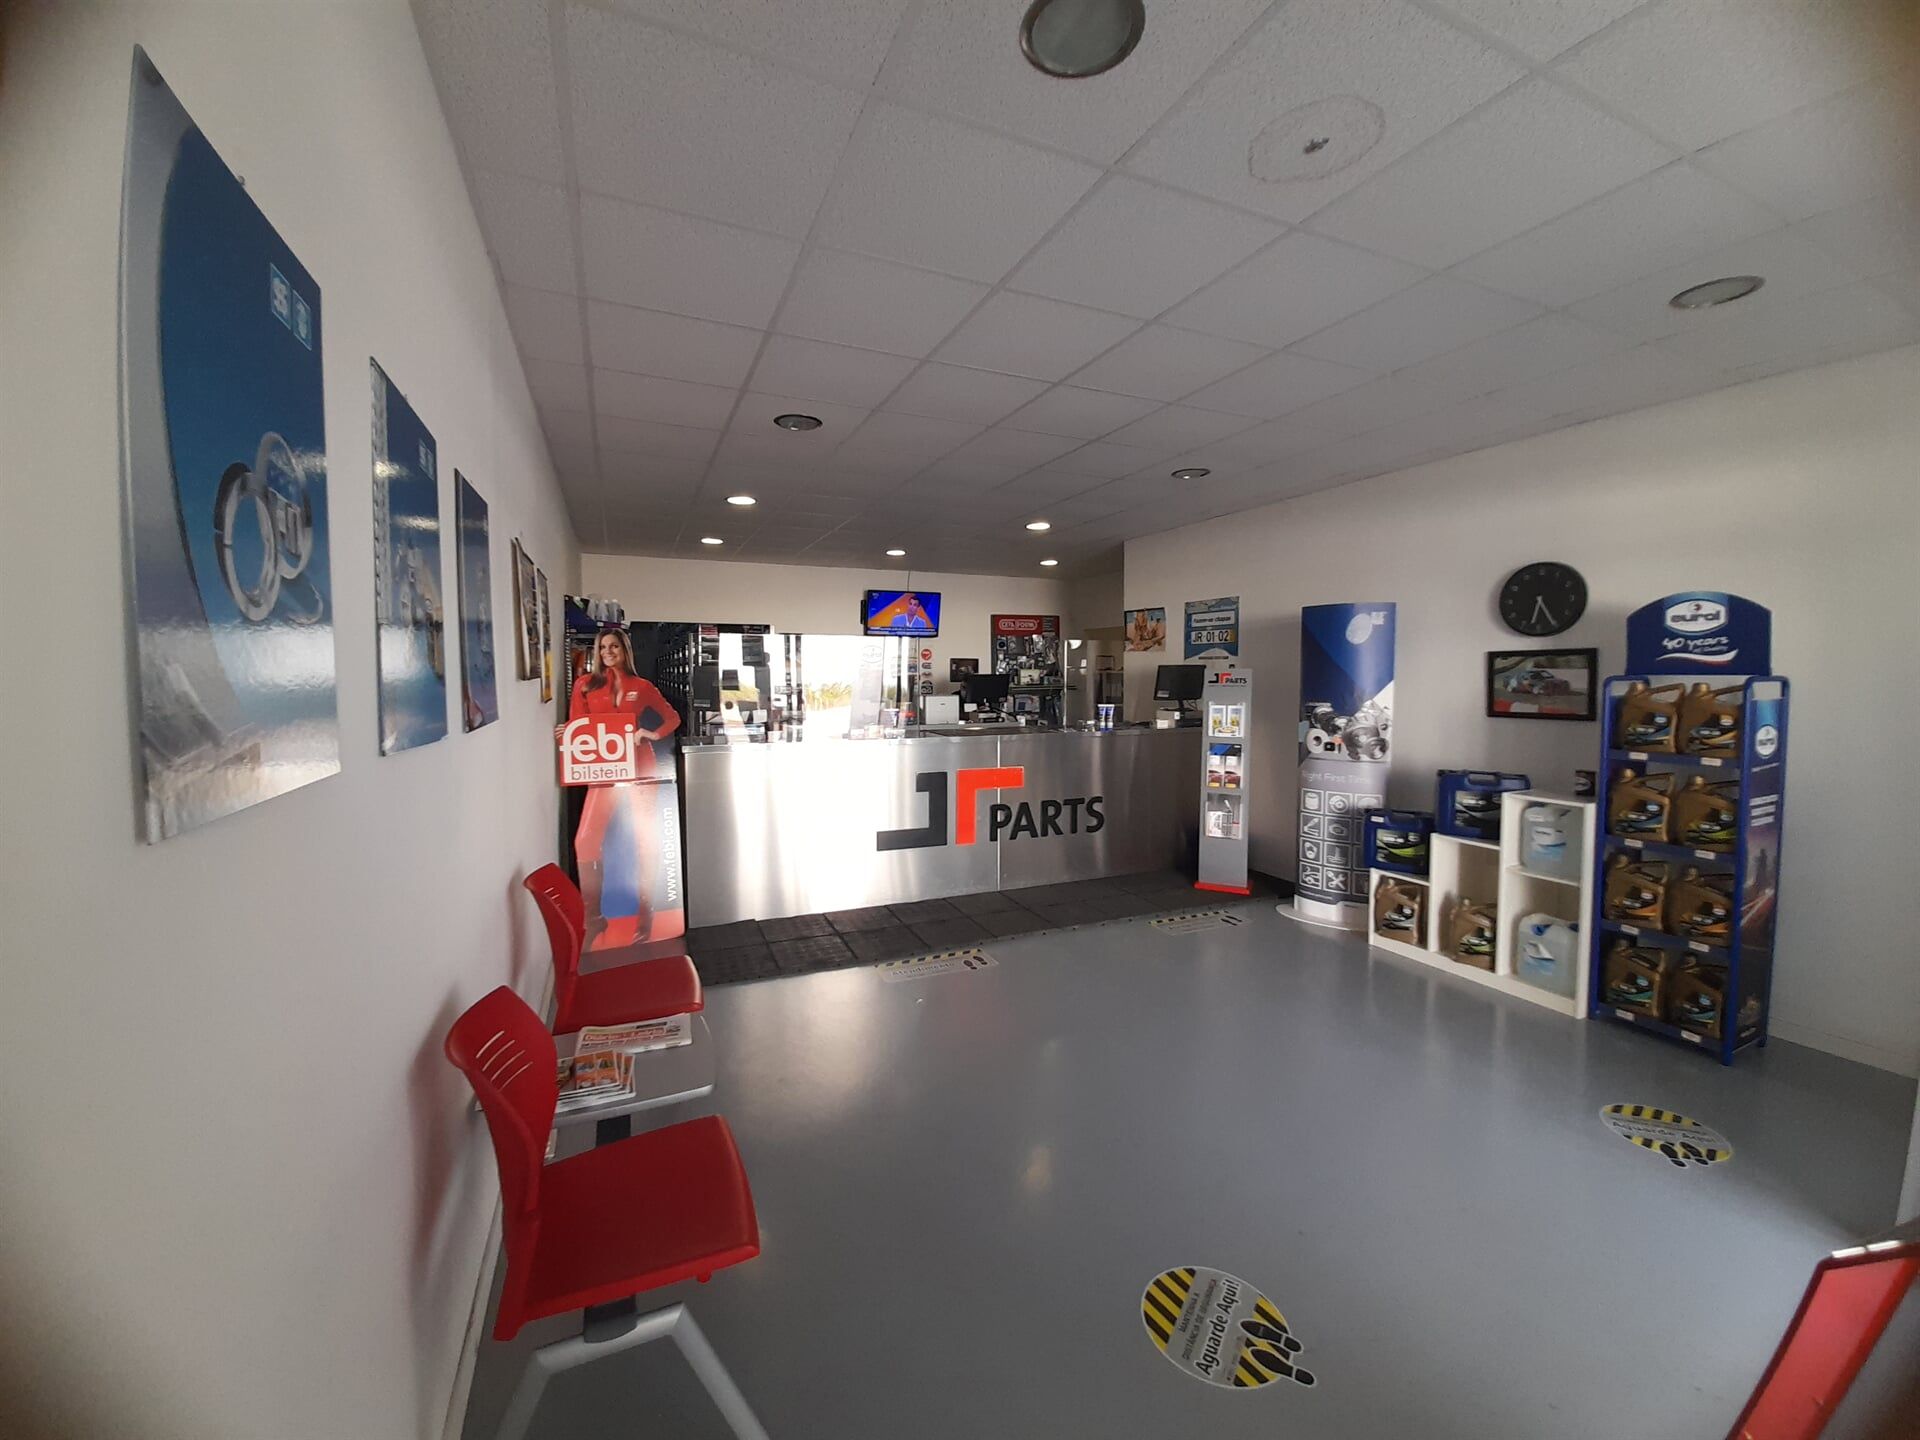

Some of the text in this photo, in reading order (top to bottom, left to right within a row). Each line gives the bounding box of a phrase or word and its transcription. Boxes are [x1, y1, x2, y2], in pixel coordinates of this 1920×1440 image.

[1662, 636, 1729, 651] 40 years
[559, 717, 634, 767] febi
[571, 764, 629, 781] bilstein
[989, 795, 1106, 842] PARTS
[1195, 1313, 1229, 1376] Aguarde
[1216, 1278, 1241, 1316] Aqui!
